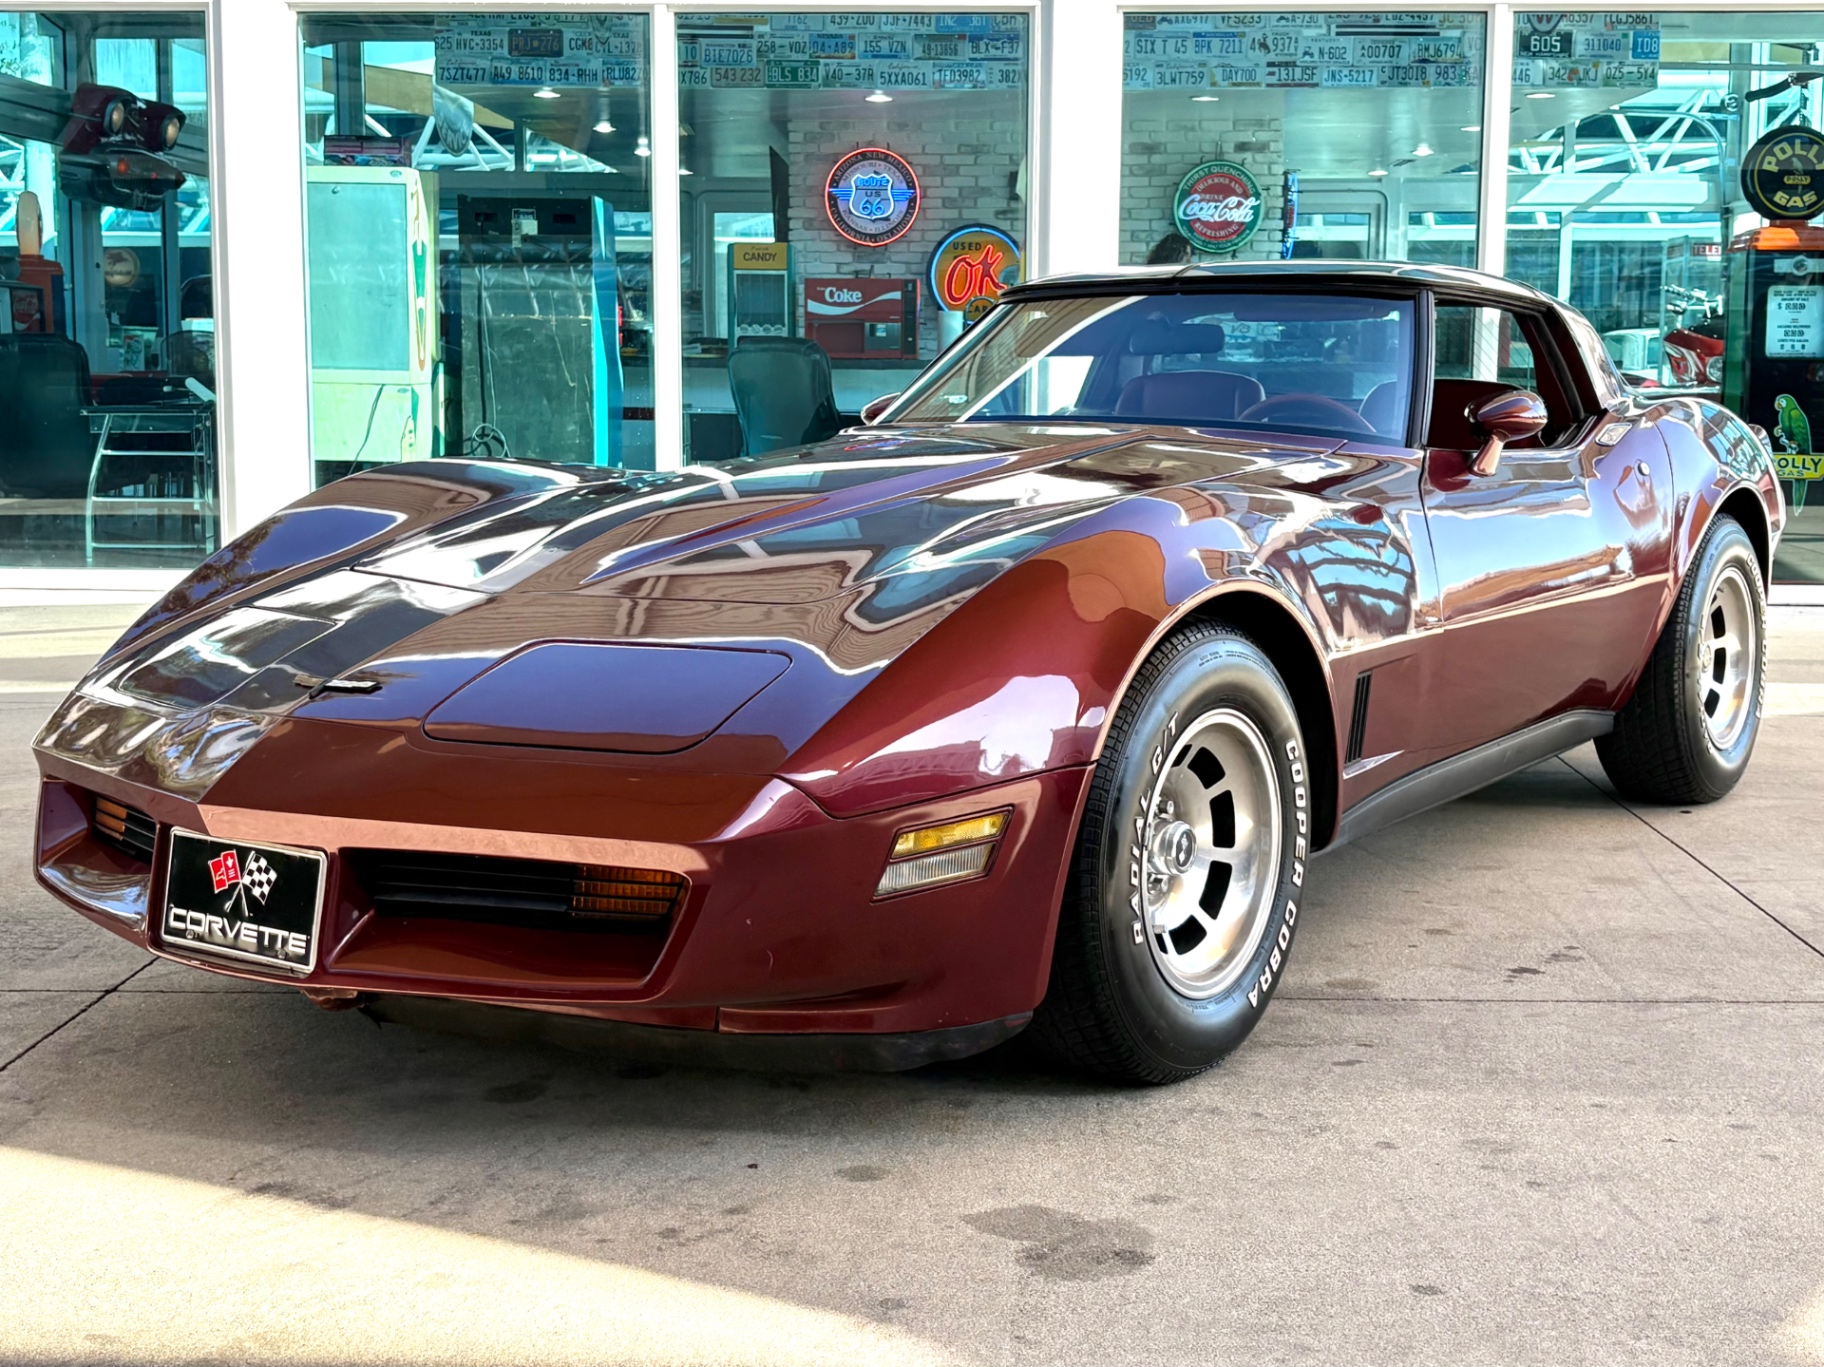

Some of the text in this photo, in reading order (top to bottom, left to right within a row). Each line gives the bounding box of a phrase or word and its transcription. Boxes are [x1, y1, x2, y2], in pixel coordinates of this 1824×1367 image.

[606, 66, 639, 80] RLU82
[857, 177, 888, 187] ROUTE
[860, 197, 885, 216] 66
[1773, 190, 1818, 208] GAS
[953, 242, 982, 251] USED
[743, 252, 778, 262] CANDY
[944, 244, 1009, 305] OK
[825, 286, 863, 303] Coke
[966, 305, 990, 314] CAR
[1776, 457, 1823, 473] OLLY
[1776, 469, 1805, 477] GAS
[1130, 790, 1151, 945] RADIAL
[1248, 738, 1307, 1008] COOPER COBRA
[168, 906, 309, 954] CORVETTE
